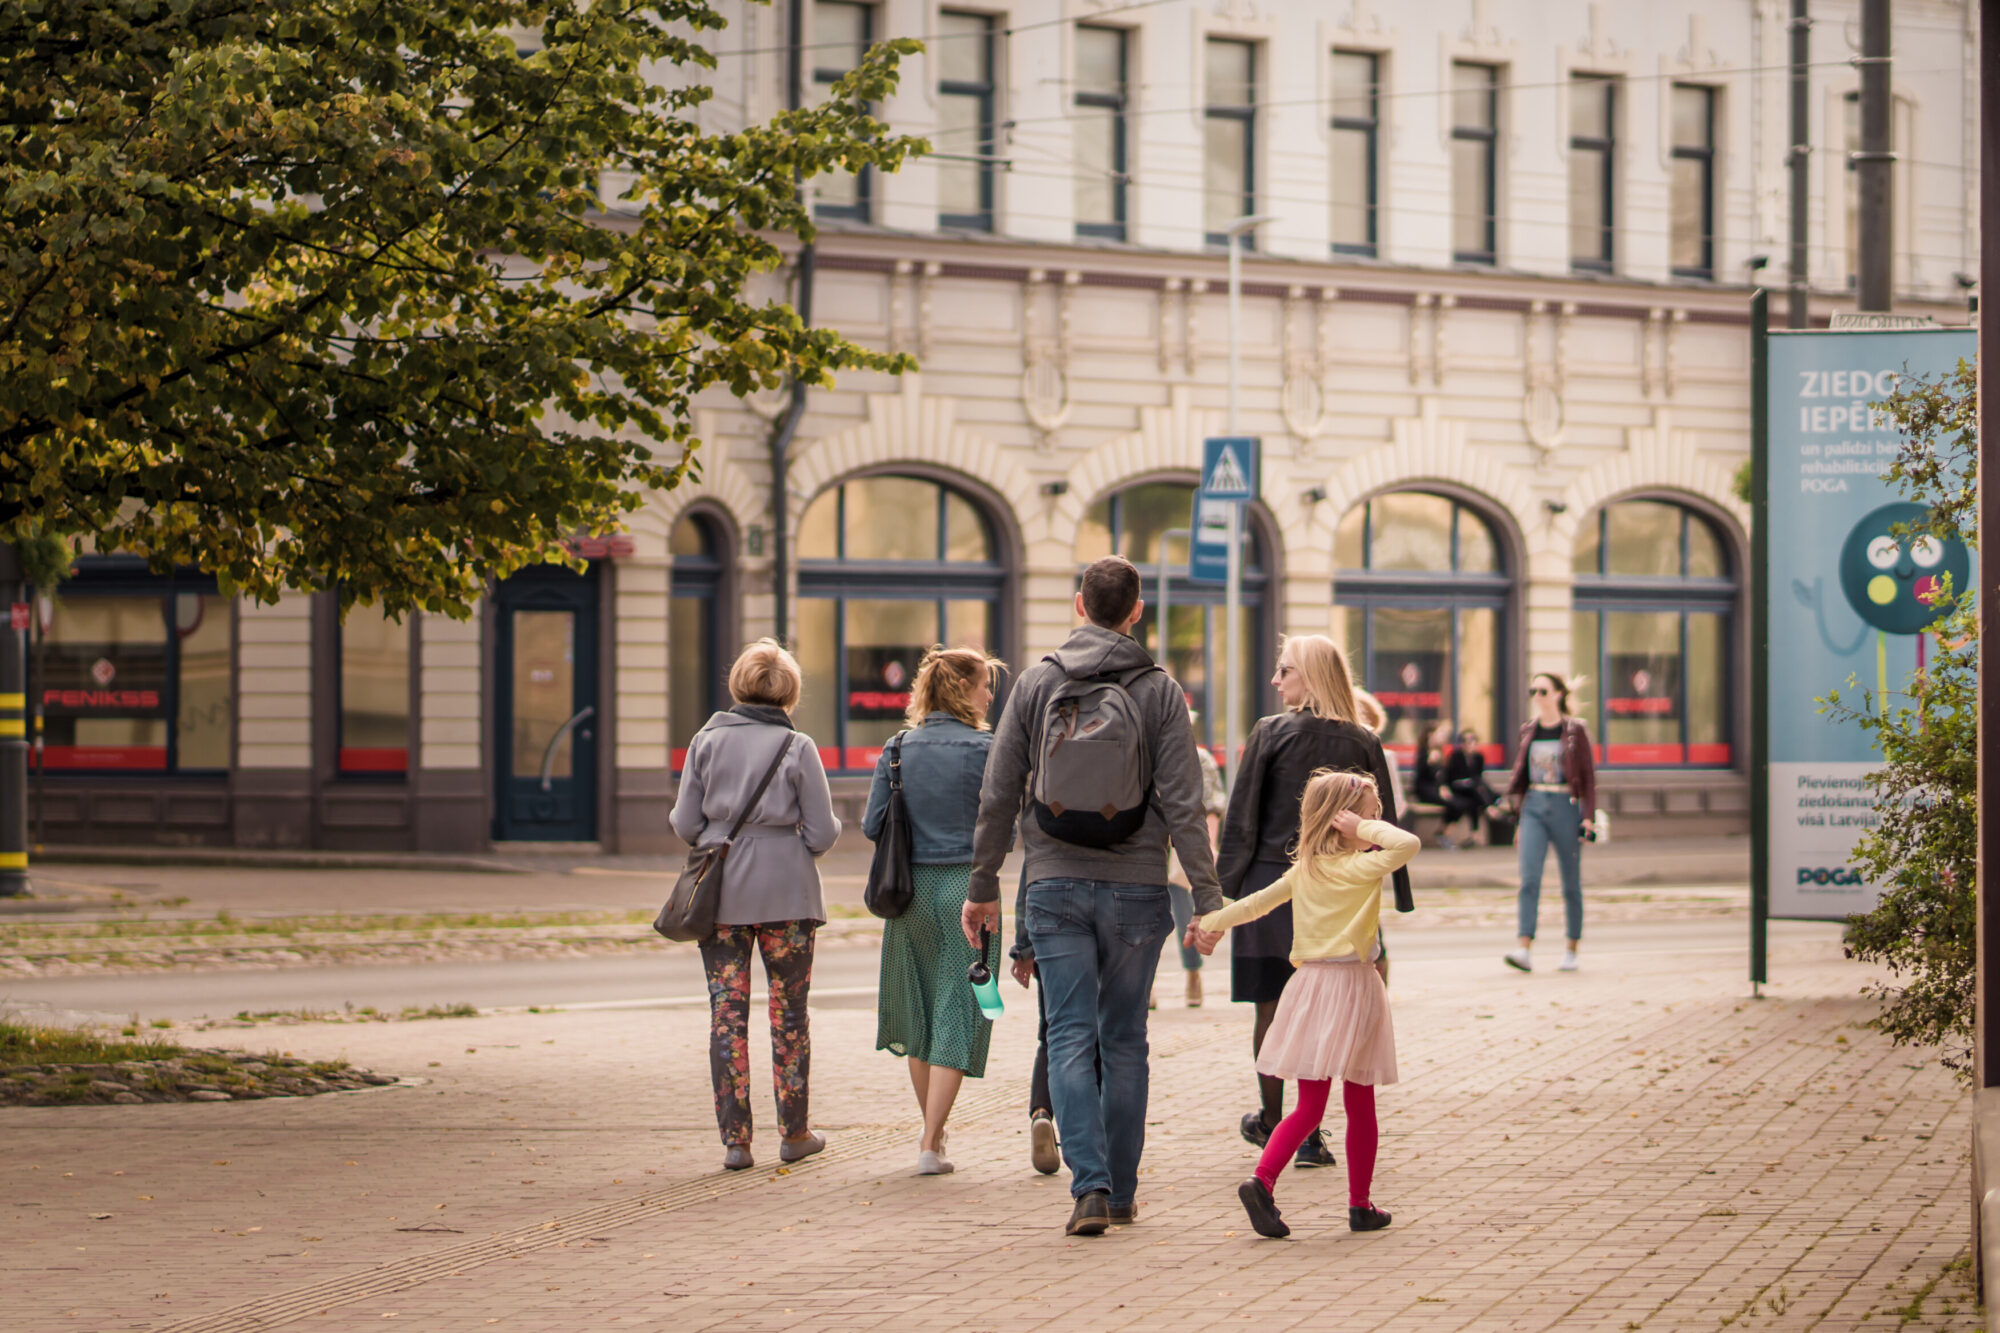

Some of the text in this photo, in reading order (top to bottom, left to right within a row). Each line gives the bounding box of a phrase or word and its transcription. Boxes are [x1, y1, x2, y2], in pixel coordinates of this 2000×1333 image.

[1799, 370, 1900, 398] ZIEDO
[1801, 444, 1820, 455] un
[1801, 478, 1848, 493] POGA
[43, 690, 159, 707] FENIKSS
[1797, 813, 1825, 826] visā
[1797, 866, 1863, 886] POGA
